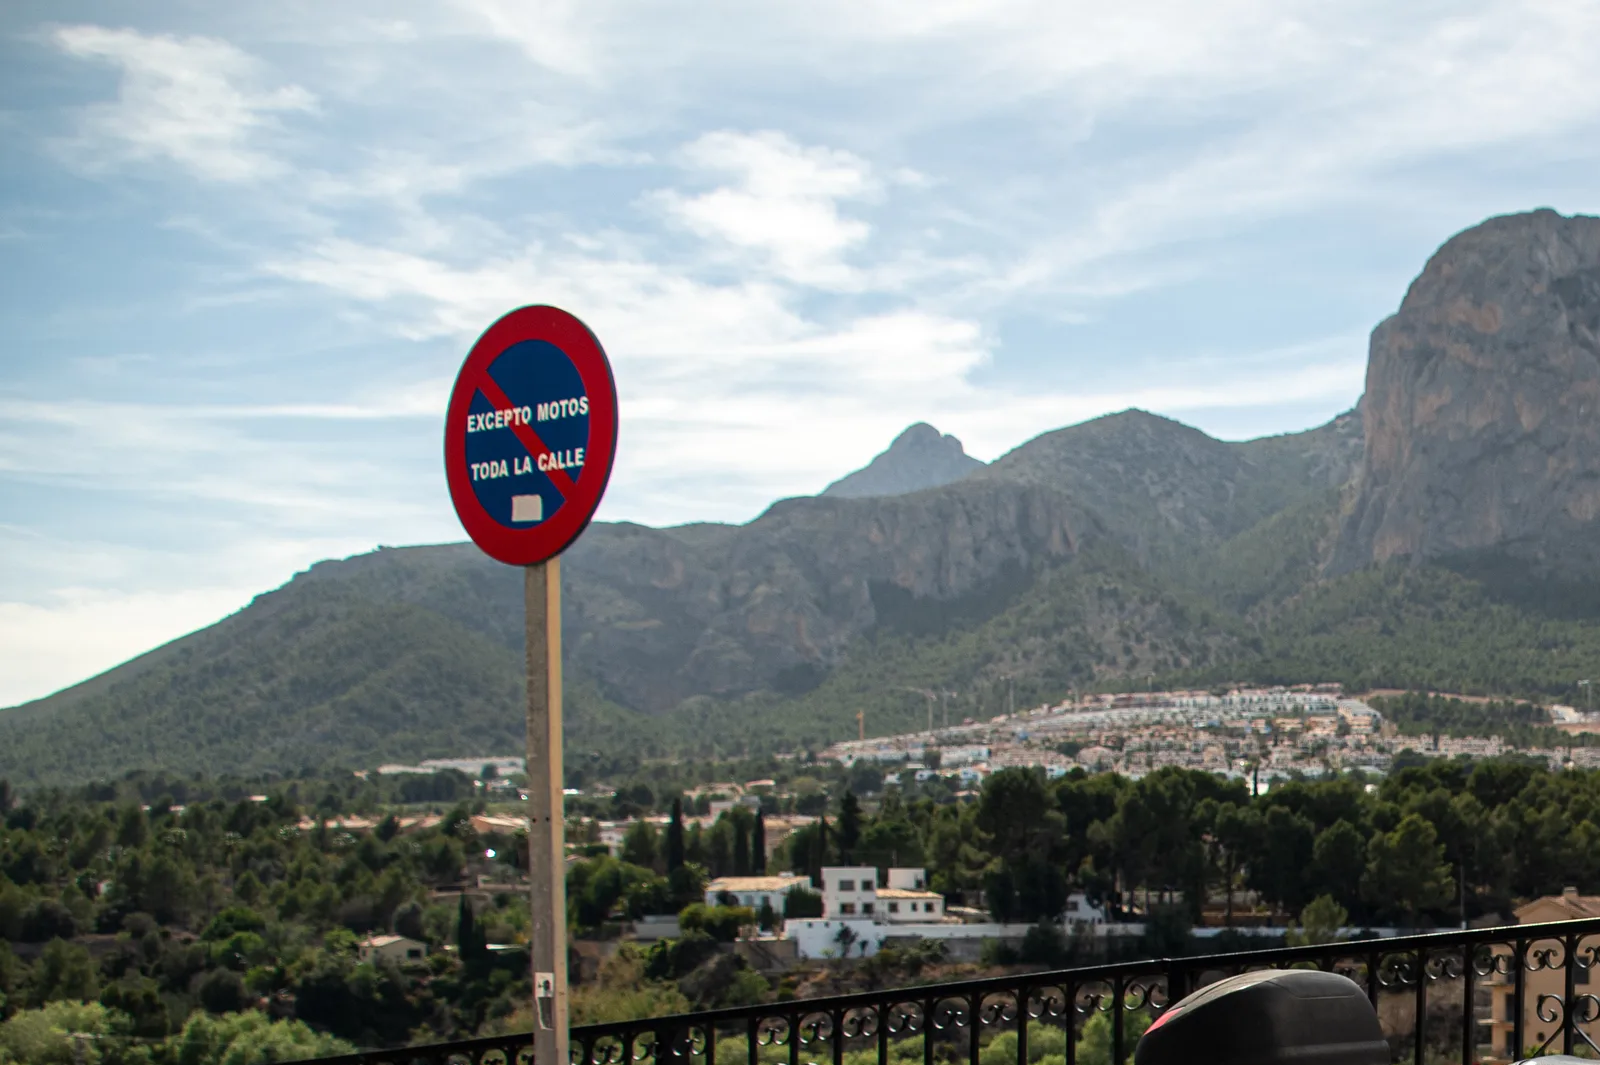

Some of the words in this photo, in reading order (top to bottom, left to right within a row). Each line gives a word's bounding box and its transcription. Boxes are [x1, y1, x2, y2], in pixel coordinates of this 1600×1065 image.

[467, 406, 532, 433] EXCEPTO
[537, 396, 589, 421] MOTOS
[471, 459, 509, 481] TODA
[514, 455, 533, 475] LA
[537, 447, 585, 472] CALLE
